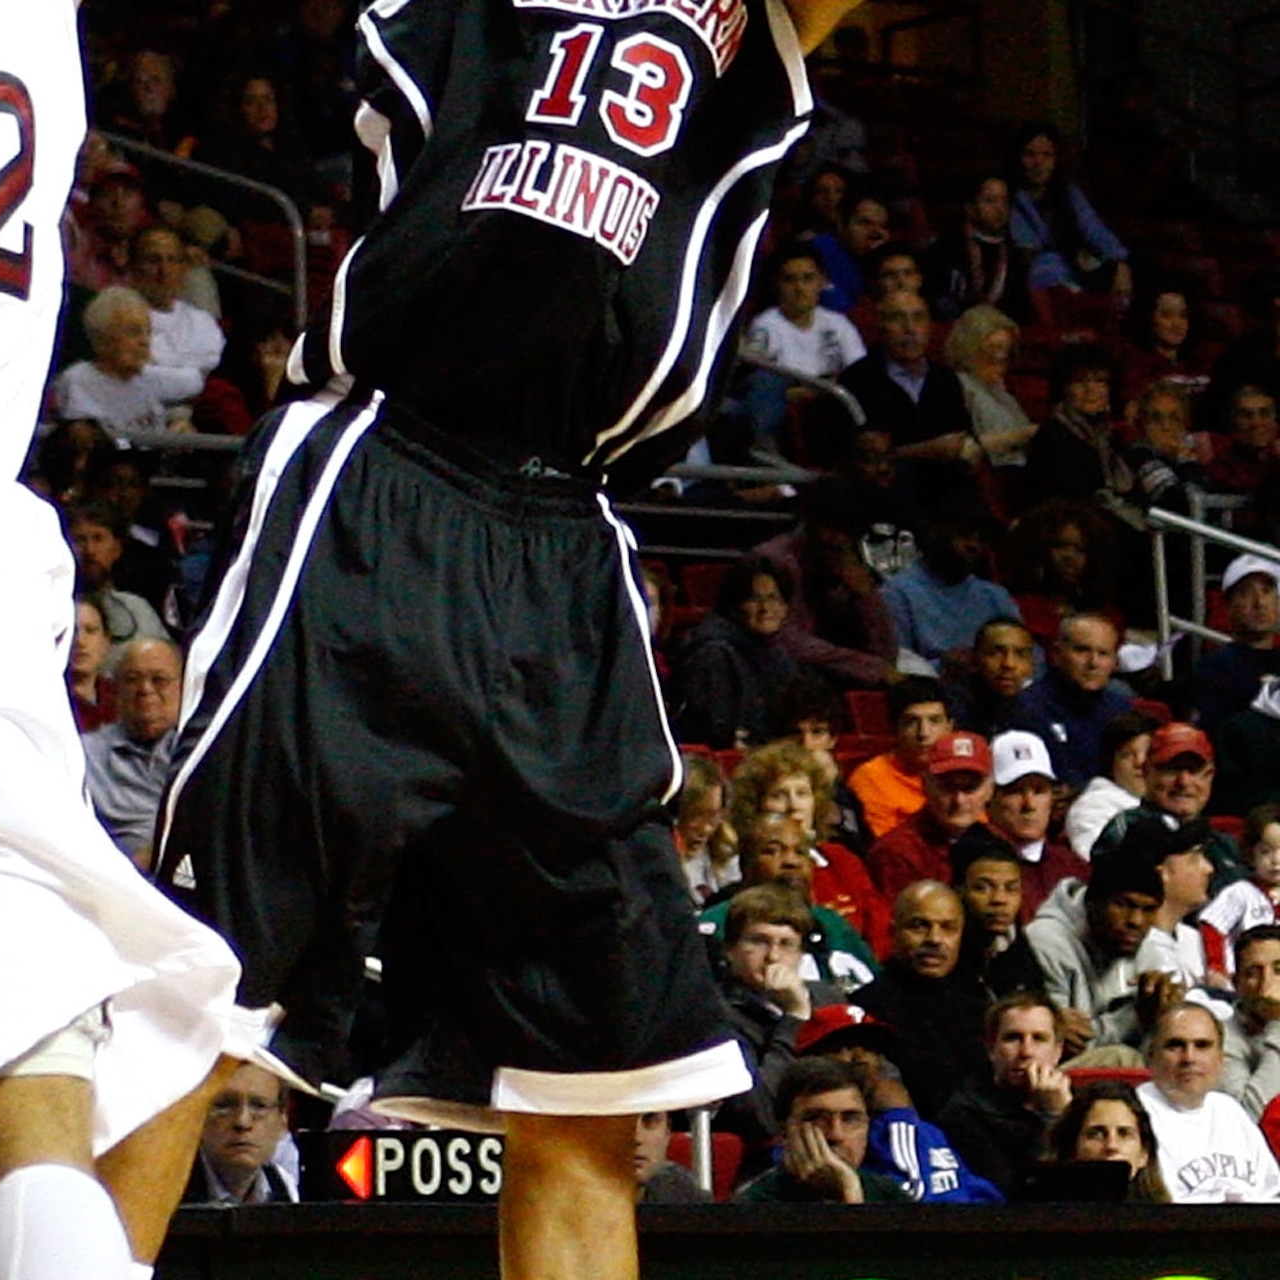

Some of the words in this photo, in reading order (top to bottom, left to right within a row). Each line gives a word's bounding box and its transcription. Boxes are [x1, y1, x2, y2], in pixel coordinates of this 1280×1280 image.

[525, 22, 693, 158] 13
[461, 139, 660, 265] ILLINOIS
[375, 1137, 503, 1196] POSS
